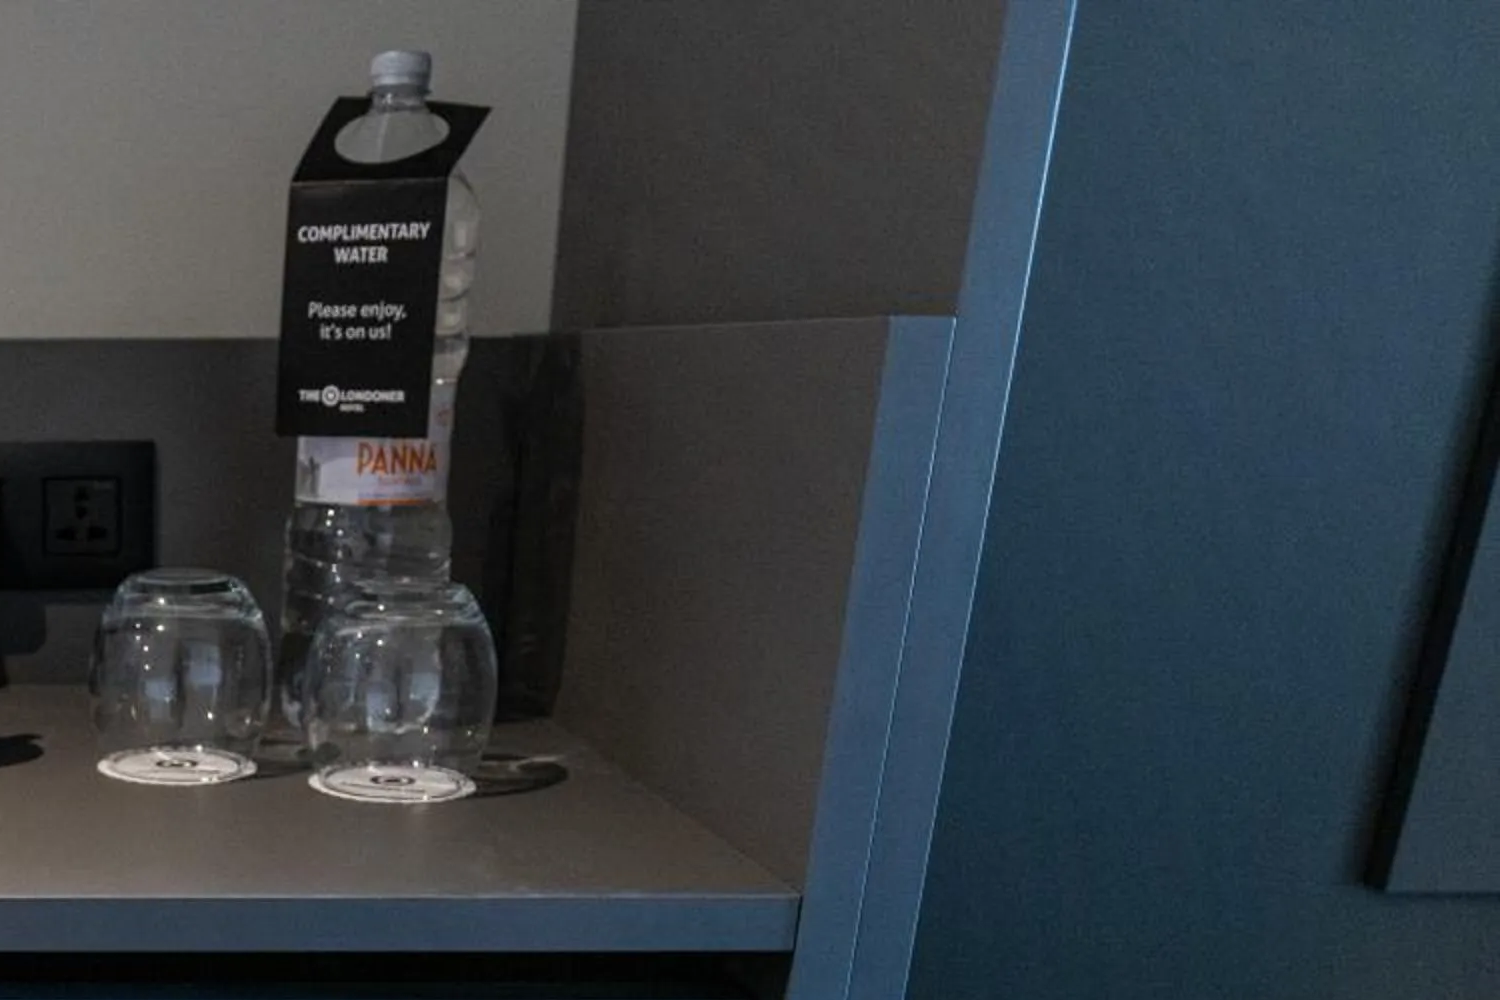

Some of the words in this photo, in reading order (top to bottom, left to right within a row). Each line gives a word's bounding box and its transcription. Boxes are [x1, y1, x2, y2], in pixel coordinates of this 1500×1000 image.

[298, 221, 431, 243] COMPLIMENTARY
[333, 245, 389, 263] WATER
[308, 301, 357, 319] Please
[320, 322, 342, 340] it's
[346, 326, 365, 340] on
[369, 324, 392, 340] us!
[298, 388, 320, 402] THE
[356, 441, 438, 476] PANNA
